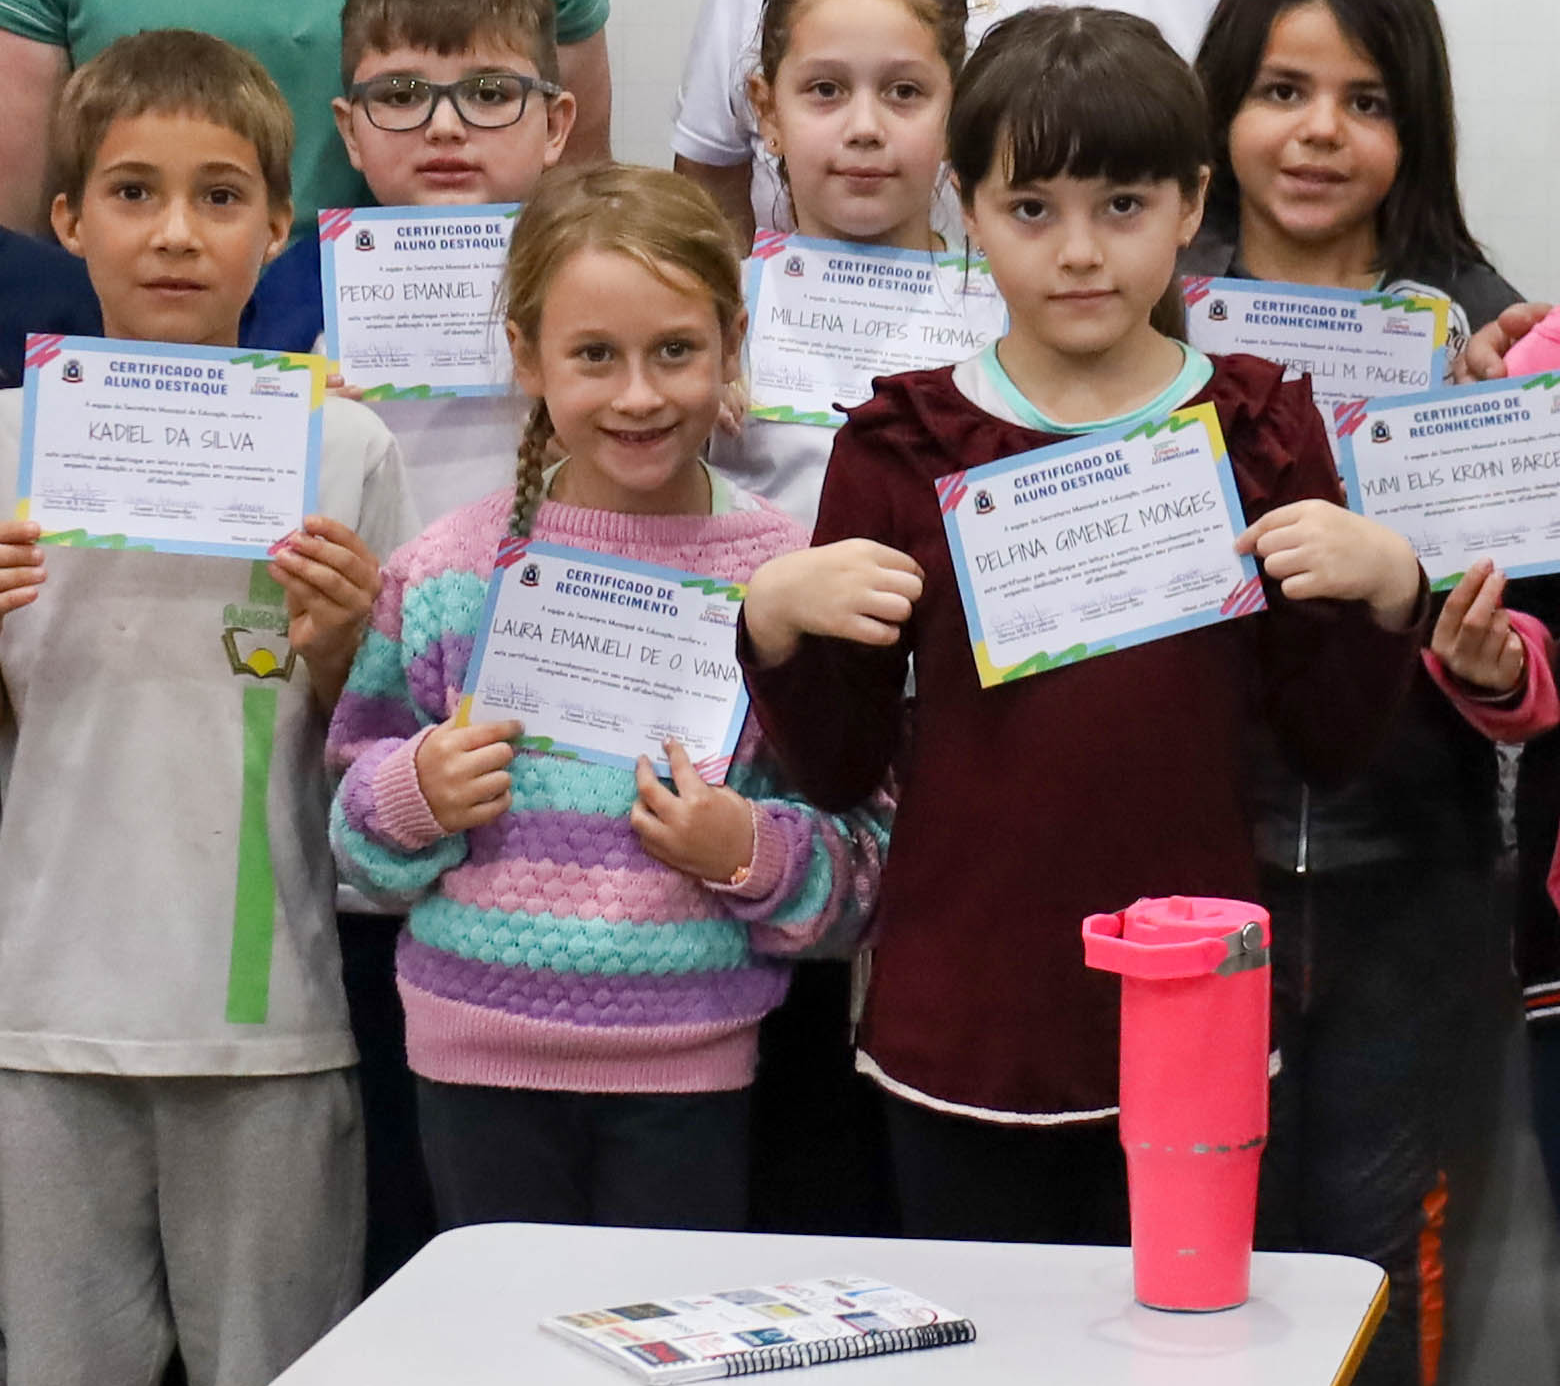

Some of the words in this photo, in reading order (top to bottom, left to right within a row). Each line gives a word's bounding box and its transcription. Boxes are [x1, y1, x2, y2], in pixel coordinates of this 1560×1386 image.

[397, 224, 481, 238] CERTIFICADO
[440, 238, 506, 250] DESTAQUE
[340, 283, 394, 302] PEDRO
[404, 281, 483, 301] EMANUEL
[771, 307, 844, 333] MILLENA
[852, 319, 908, 340] LOPES
[919, 325, 988, 350] THOMAS
[1245, 312, 1363, 333] RECONHECIMENTO
[110, 361, 204, 379] CERTIFICADO
[208, 368, 225, 380] DE
[1365, 364, 1429, 387] PACHECO
[104, 376, 151, 390] ALUNO
[155, 379, 228, 396] DESTAQUE
[89, 421, 153, 445] KADIEL
[165, 426, 190, 447] DA
[201, 429, 254, 452] SILVA
[1060, 463, 1132, 493] DESTAQUE
[1360, 474, 1401, 496] YUMI
[1408, 469, 1444, 492] ELIS
[1451, 459, 1504, 484] KROHN
[976, 539, 1049, 575] DELFINA
[1055, 513, 1133, 552] GIMENEZ
[1139, 490, 1218, 525] MONGES
[556, 581, 679, 617] RECONHECIMENTO
[493, 617, 543, 642] LAURA
[550, 627, 632, 659] EMANUELI
[640, 645, 662, 666] DE
[693, 658, 738, 684] VIANA
